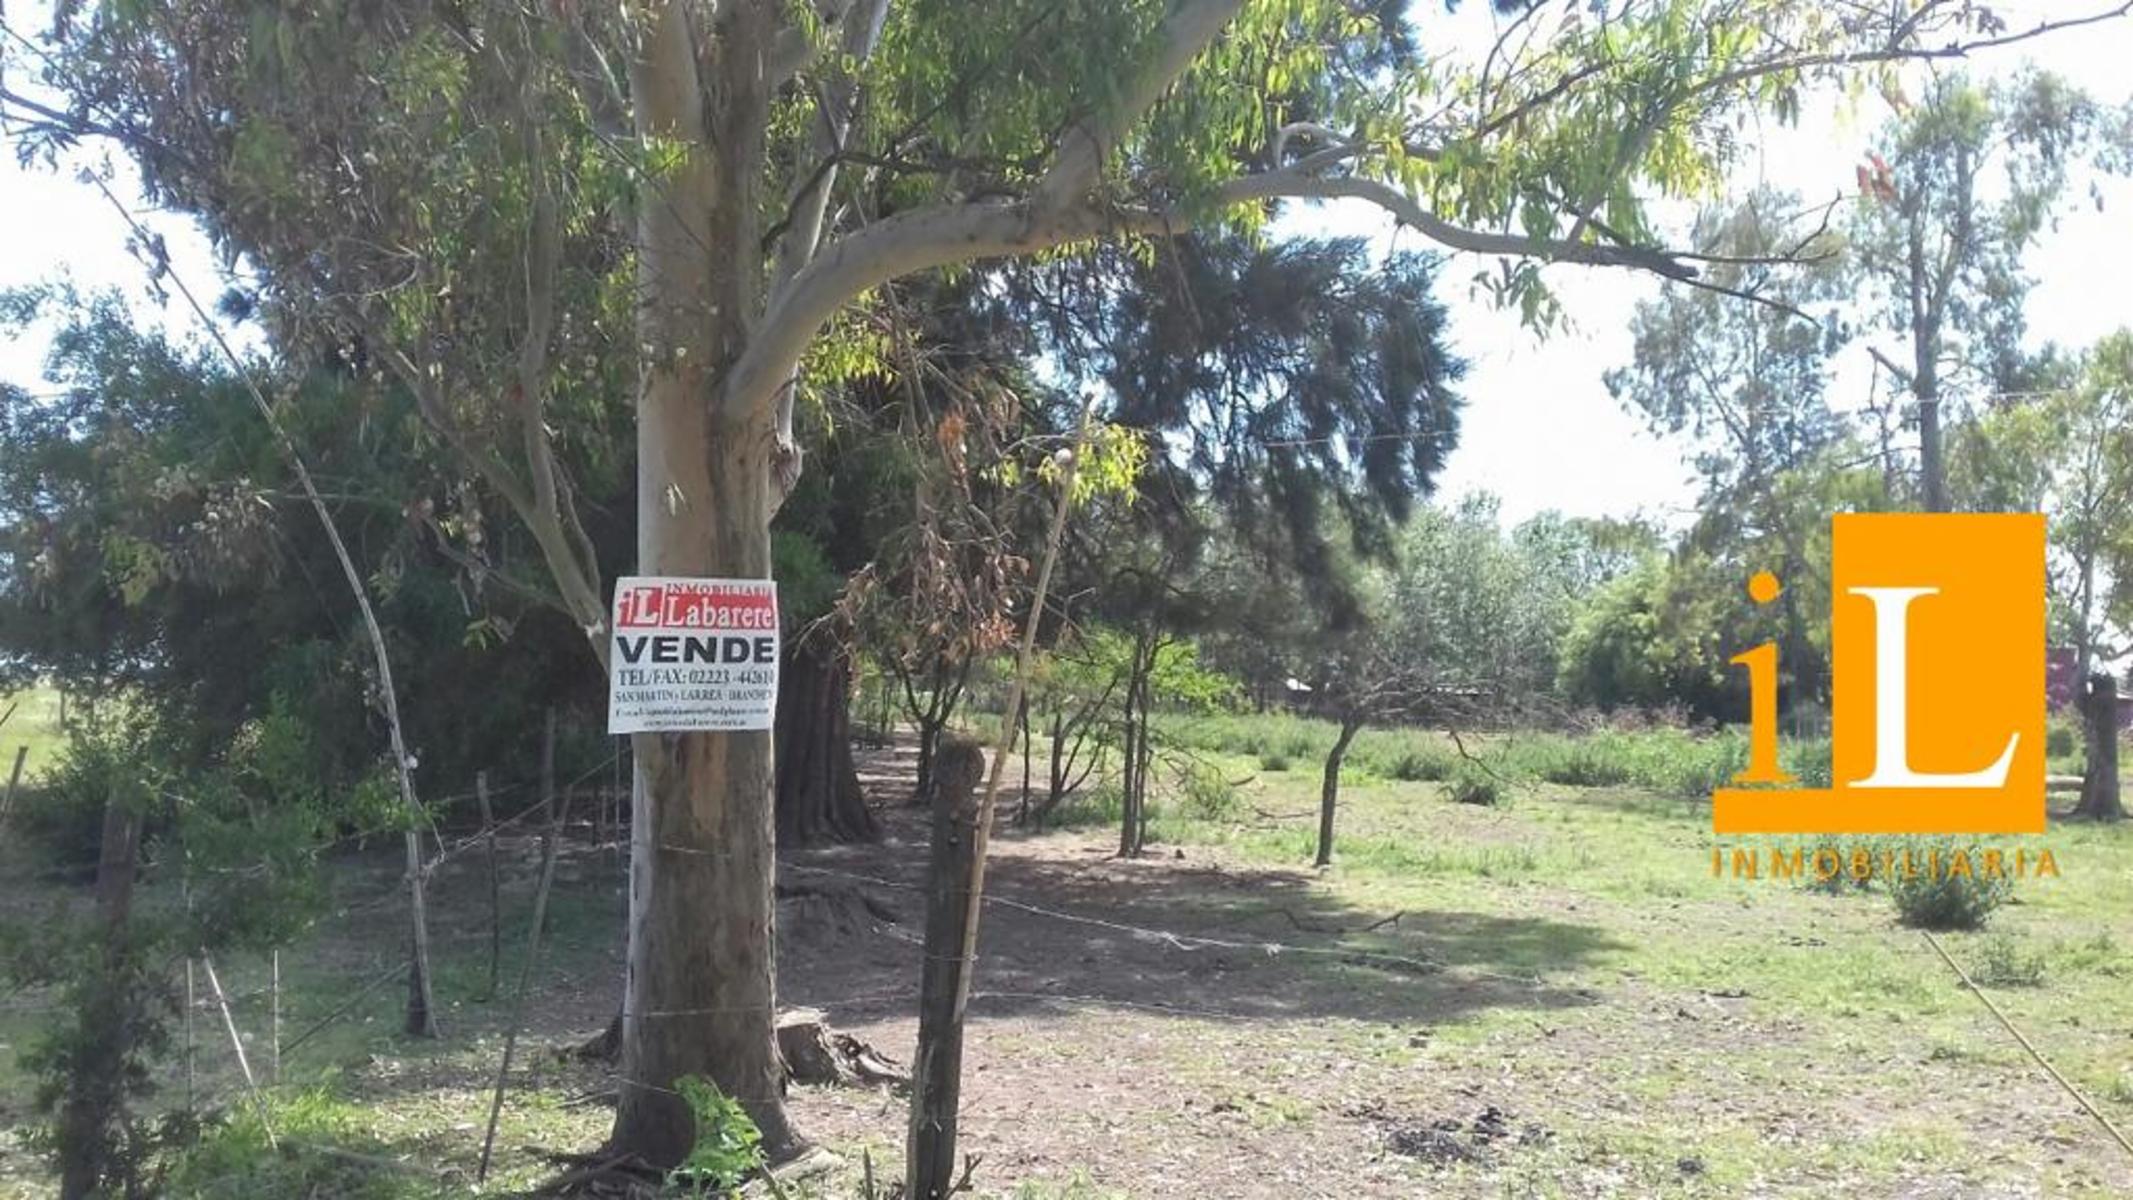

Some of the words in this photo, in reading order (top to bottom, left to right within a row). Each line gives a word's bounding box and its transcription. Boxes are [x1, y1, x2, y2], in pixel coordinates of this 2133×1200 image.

[616, 636, 774, 664] VENDE
[619, 669, 687, 686] TEL/FAX:
[689, 669, 730, 684] 02223
